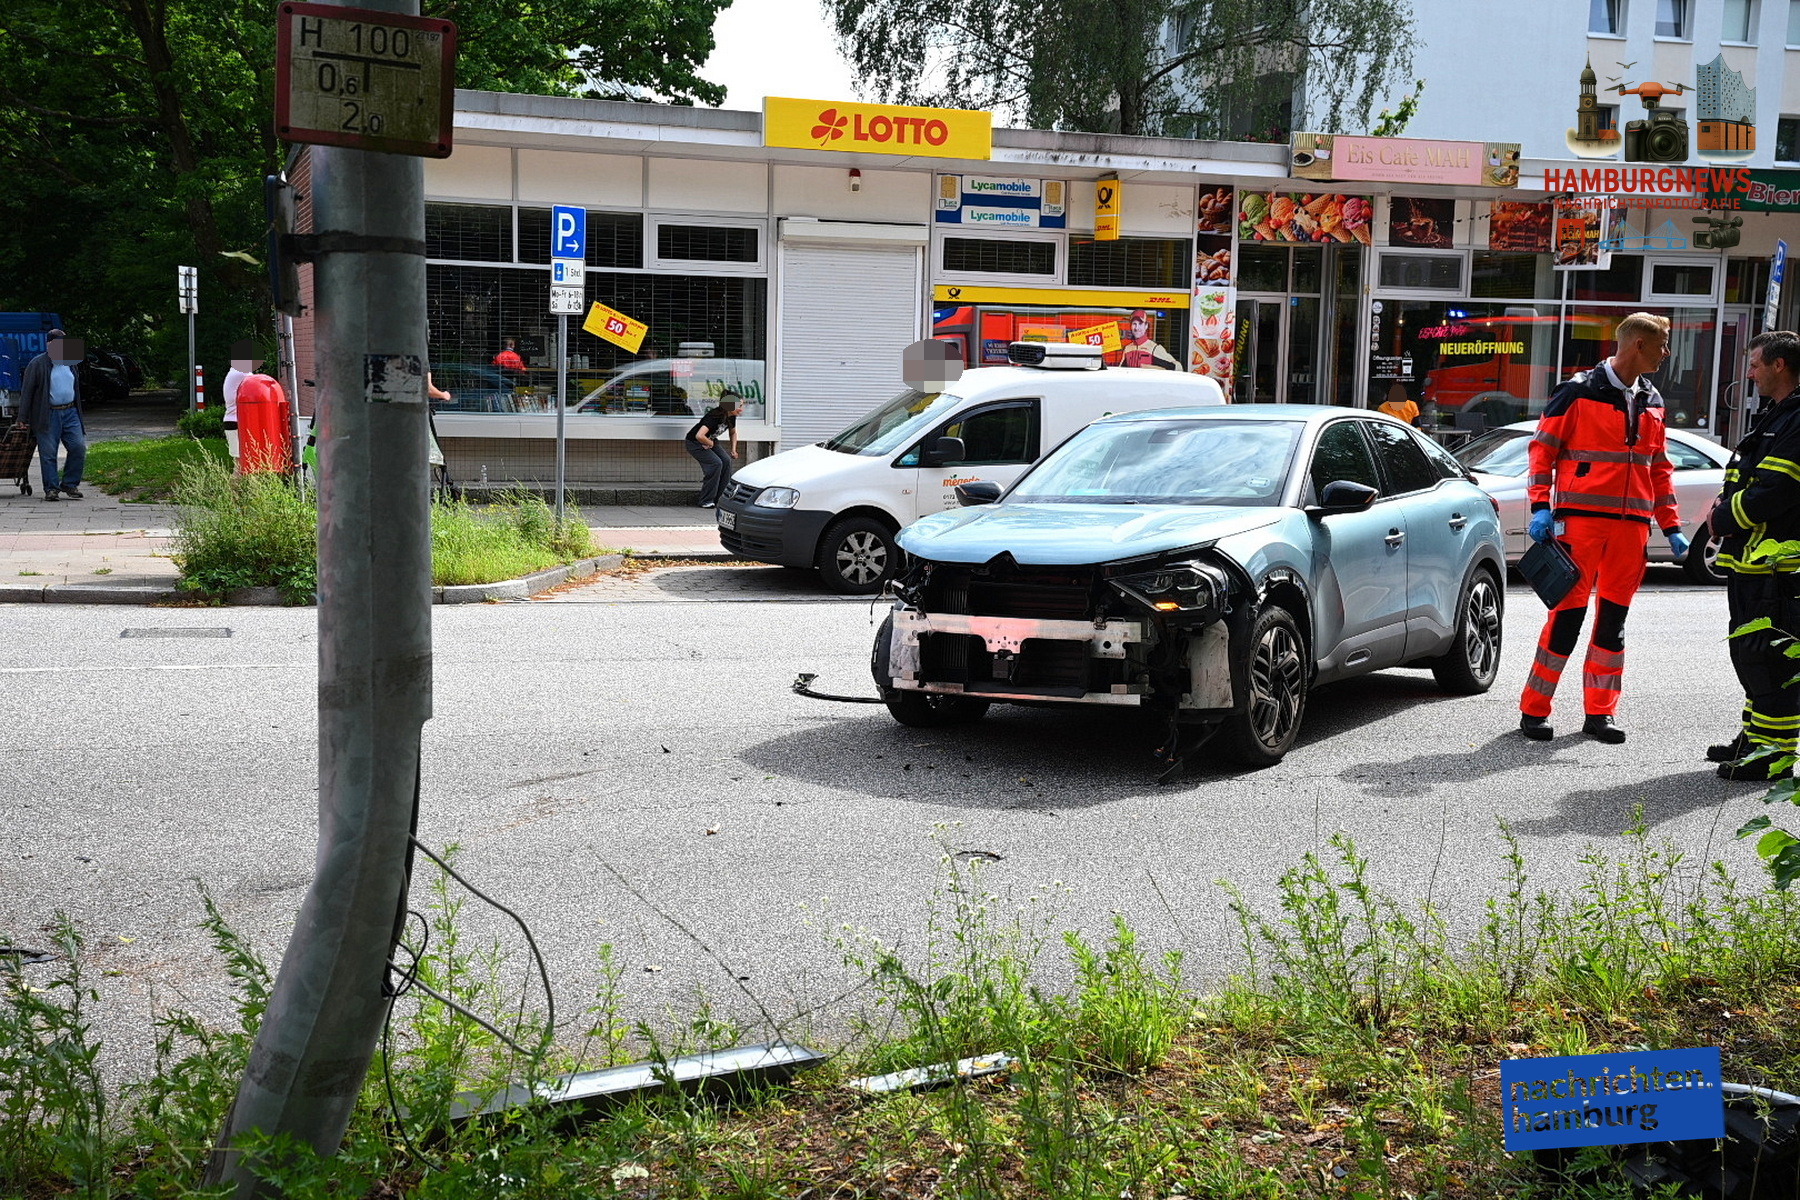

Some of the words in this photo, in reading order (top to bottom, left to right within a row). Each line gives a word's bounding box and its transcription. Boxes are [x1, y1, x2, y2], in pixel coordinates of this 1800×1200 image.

[300, 17, 322, 48] H
[350, 24, 409, 58] 100
[853, 114, 949, 147] LOTTO
[1346, 144, 1374, 165] Eis
[1424, 147, 1471, 169] MAH
[971, 179, 1031, 194] Lycamobile
[970, 211, 1031, 223] Lycamobile
[558, 212, 576, 251] P
[607, 319, 623, 334] 50
[1088, 334, 1101, 346] 50
[1439, 340, 1524, 355] NEUERÖFFNUNG
